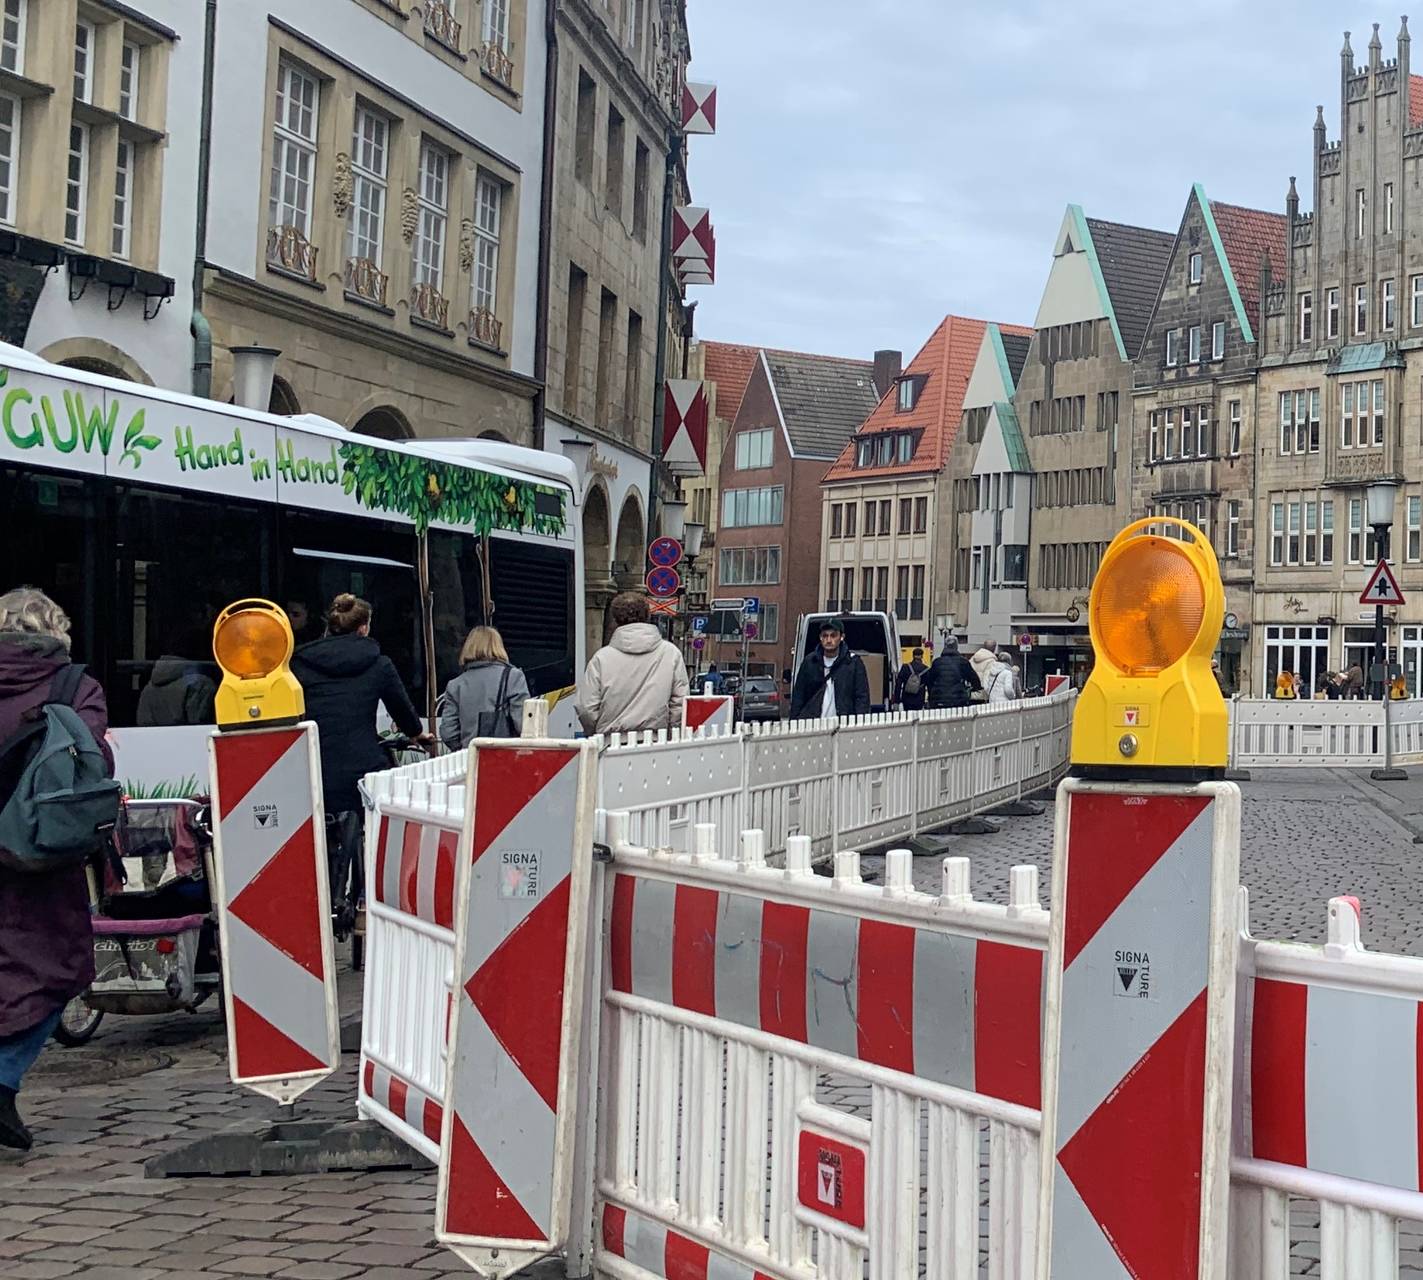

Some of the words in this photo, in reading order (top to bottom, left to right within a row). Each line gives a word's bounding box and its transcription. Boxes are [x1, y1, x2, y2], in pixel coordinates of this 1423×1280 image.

[2, 387, 119, 456] GUW
[174, 425, 244, 472] Hand
[250, 448, 271, 482] in
[277, 438, 339, 484] Hand
[696, 618, 705, 629] P
[252, 804, 277, 813] SIGNA
[502, 853, 537, 864] SIGNA
[527, 865, 537, 896] TURE
[1114, 950, 1150, 963] SIGNA
[1139, 965, 1150, 998] TURE
